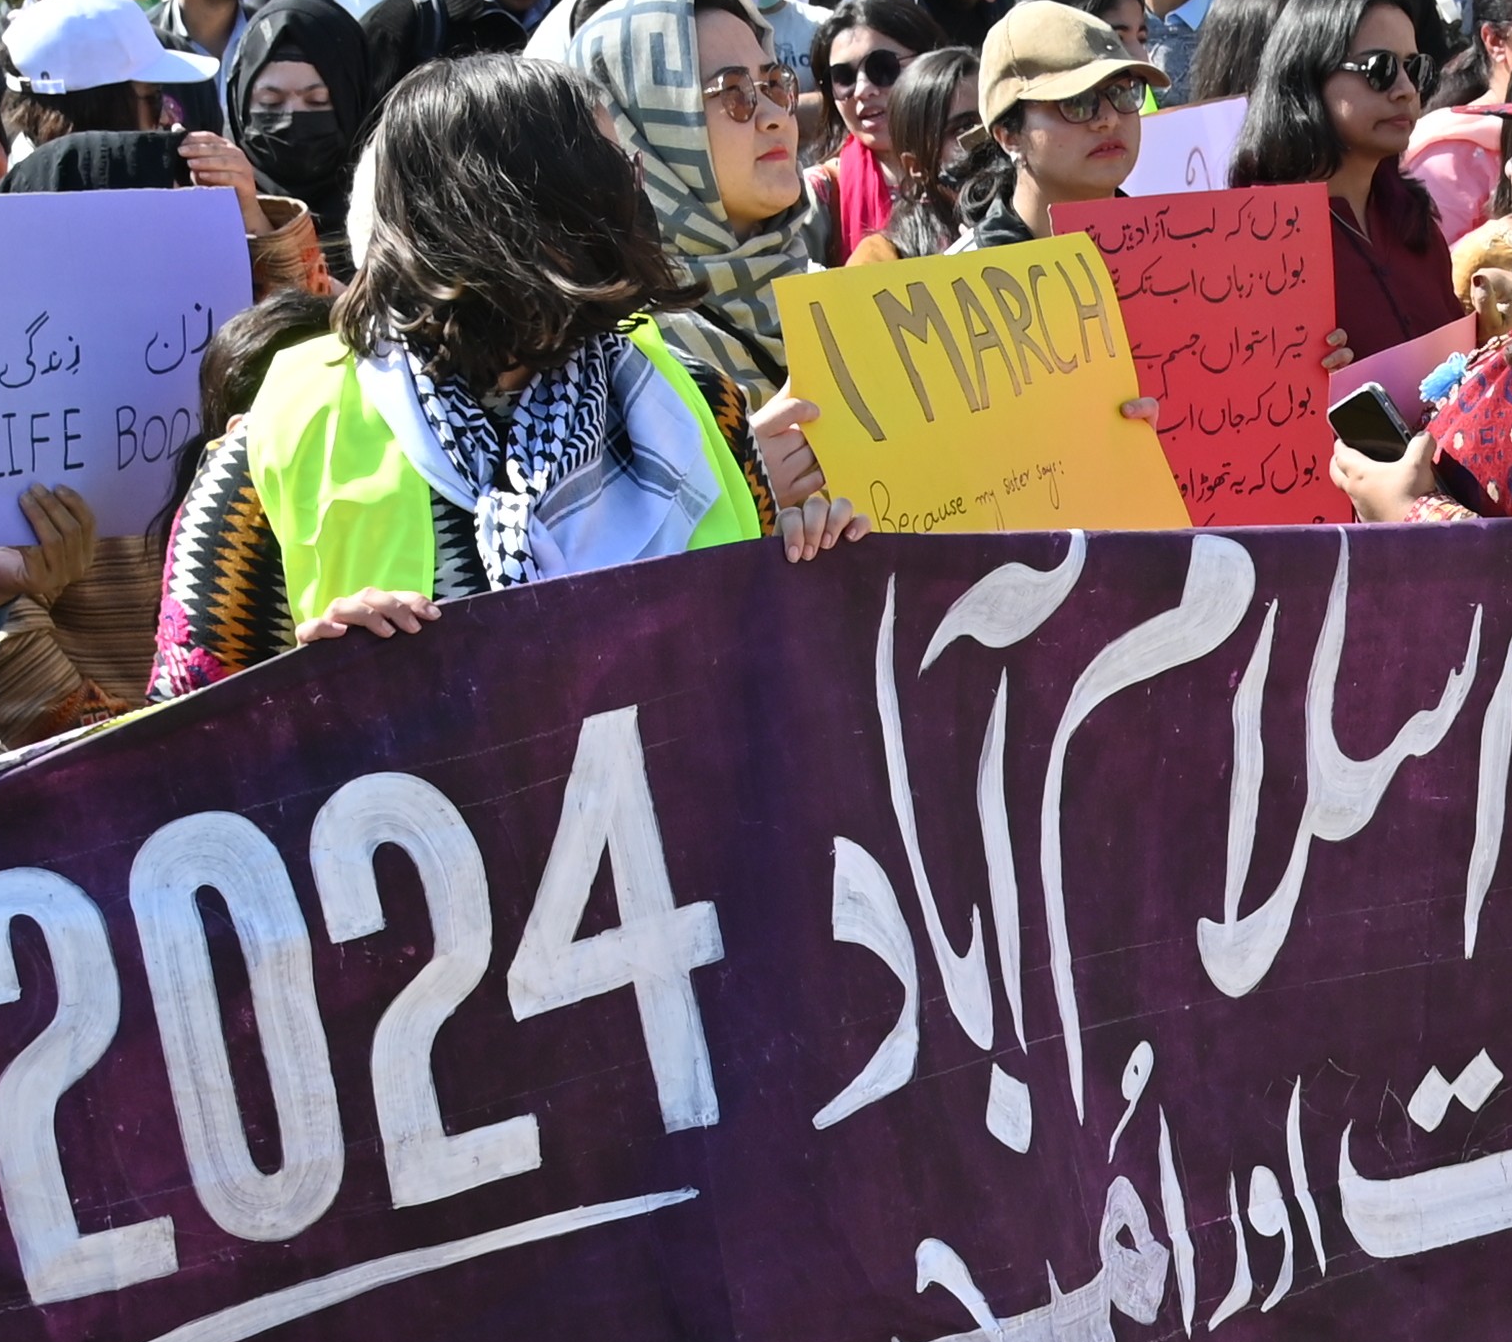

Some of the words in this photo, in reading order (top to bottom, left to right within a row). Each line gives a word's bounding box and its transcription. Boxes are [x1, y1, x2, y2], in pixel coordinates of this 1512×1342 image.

[809, 301, 886, 442] I
[872, 252, 1116, 423] MARCH
[115, 405, 202, 471] BOD
[1267, 383, 1316, 427] بول
[869, 480, 968, 534] Because
[975, 490, 1006, 531] my
[1003, 469, 1031, 496] sister
[1271, 449, 1321, 495] بول
[813, 528, 1088, 1155] آباد
[1207, 1073, 1328, 1334] اور
